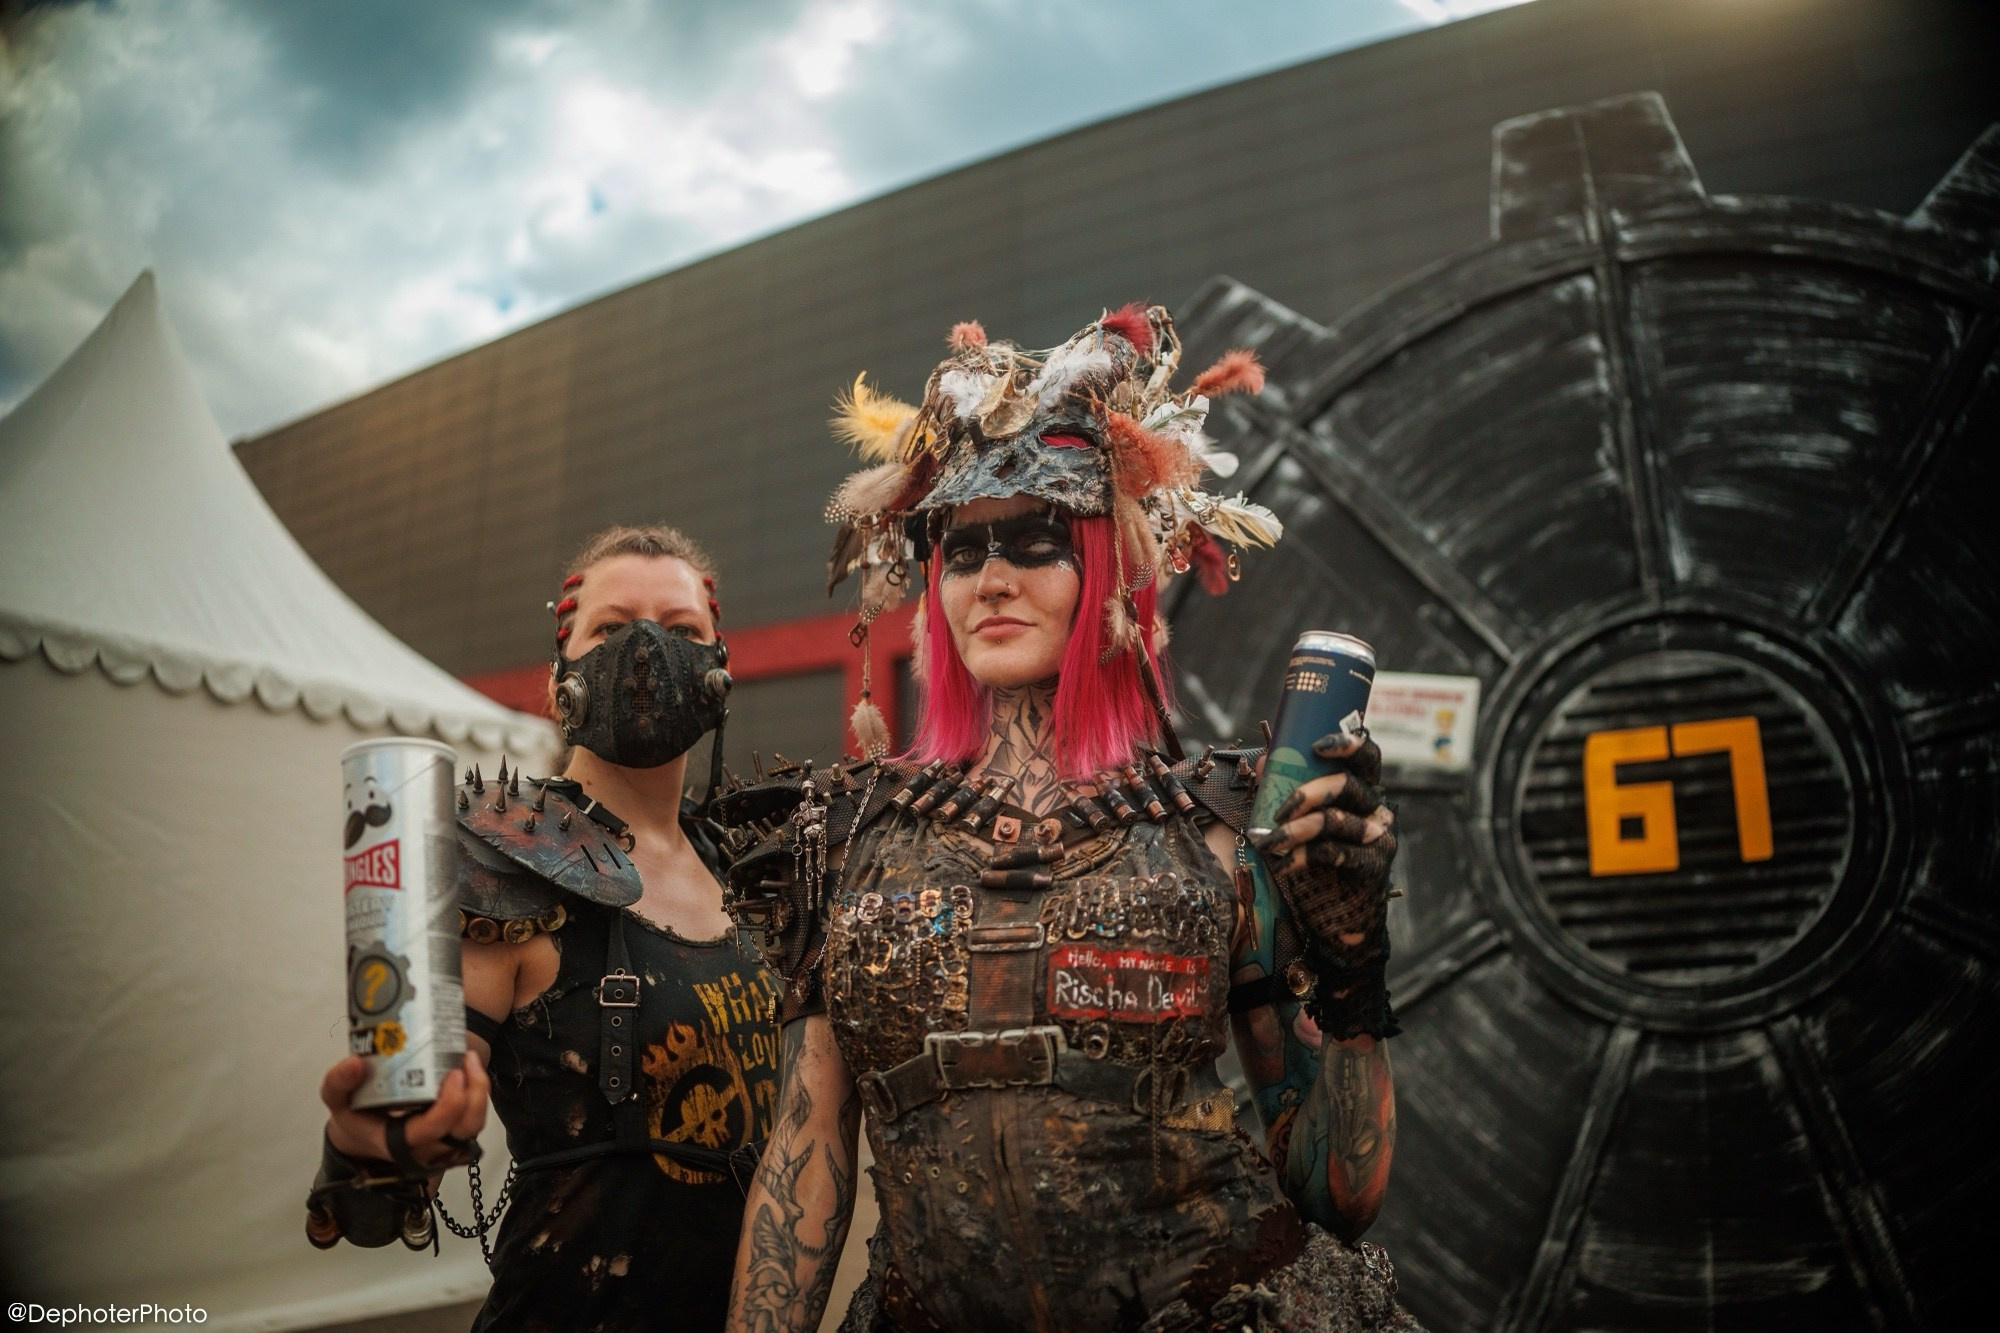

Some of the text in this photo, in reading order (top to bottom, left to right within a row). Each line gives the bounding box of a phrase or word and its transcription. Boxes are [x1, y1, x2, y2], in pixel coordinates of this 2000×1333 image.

[1584, 715, 1774, 877] 67
[1119, 956, 1136, 969] MY
[1139, 958, 1173, 972] NAME
